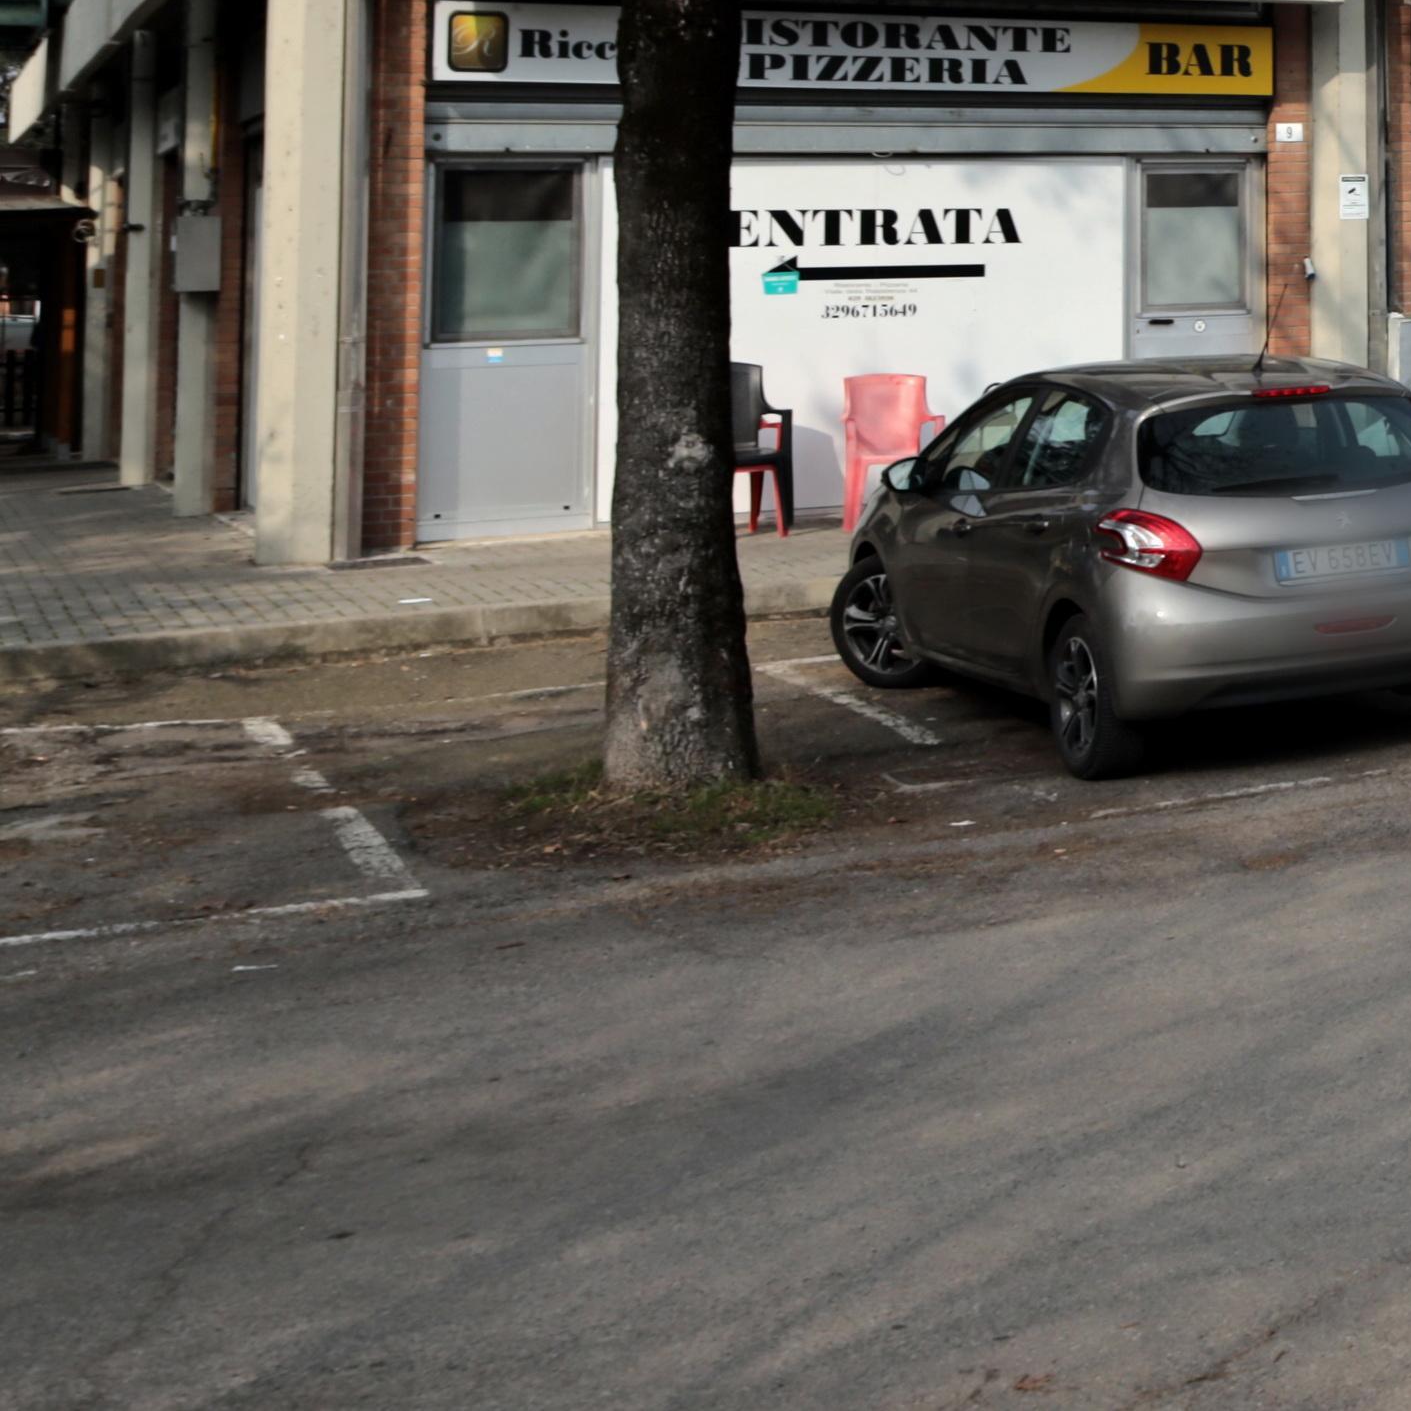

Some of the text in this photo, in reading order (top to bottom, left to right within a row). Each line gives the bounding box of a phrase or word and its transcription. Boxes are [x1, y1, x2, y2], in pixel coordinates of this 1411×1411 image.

[518, 29, 618, 59] Ricc
[742, 18, 1072, 53] ISTORANTE
[745, 53, 1028, 85] PIZZERIA
[1146, 42, 1253, 78] BAR
[1286, 126, 1293, 139] 9
[729, 208, 1022, 247] ENTRATA
[821, 303, 918, 319] 3296715649
